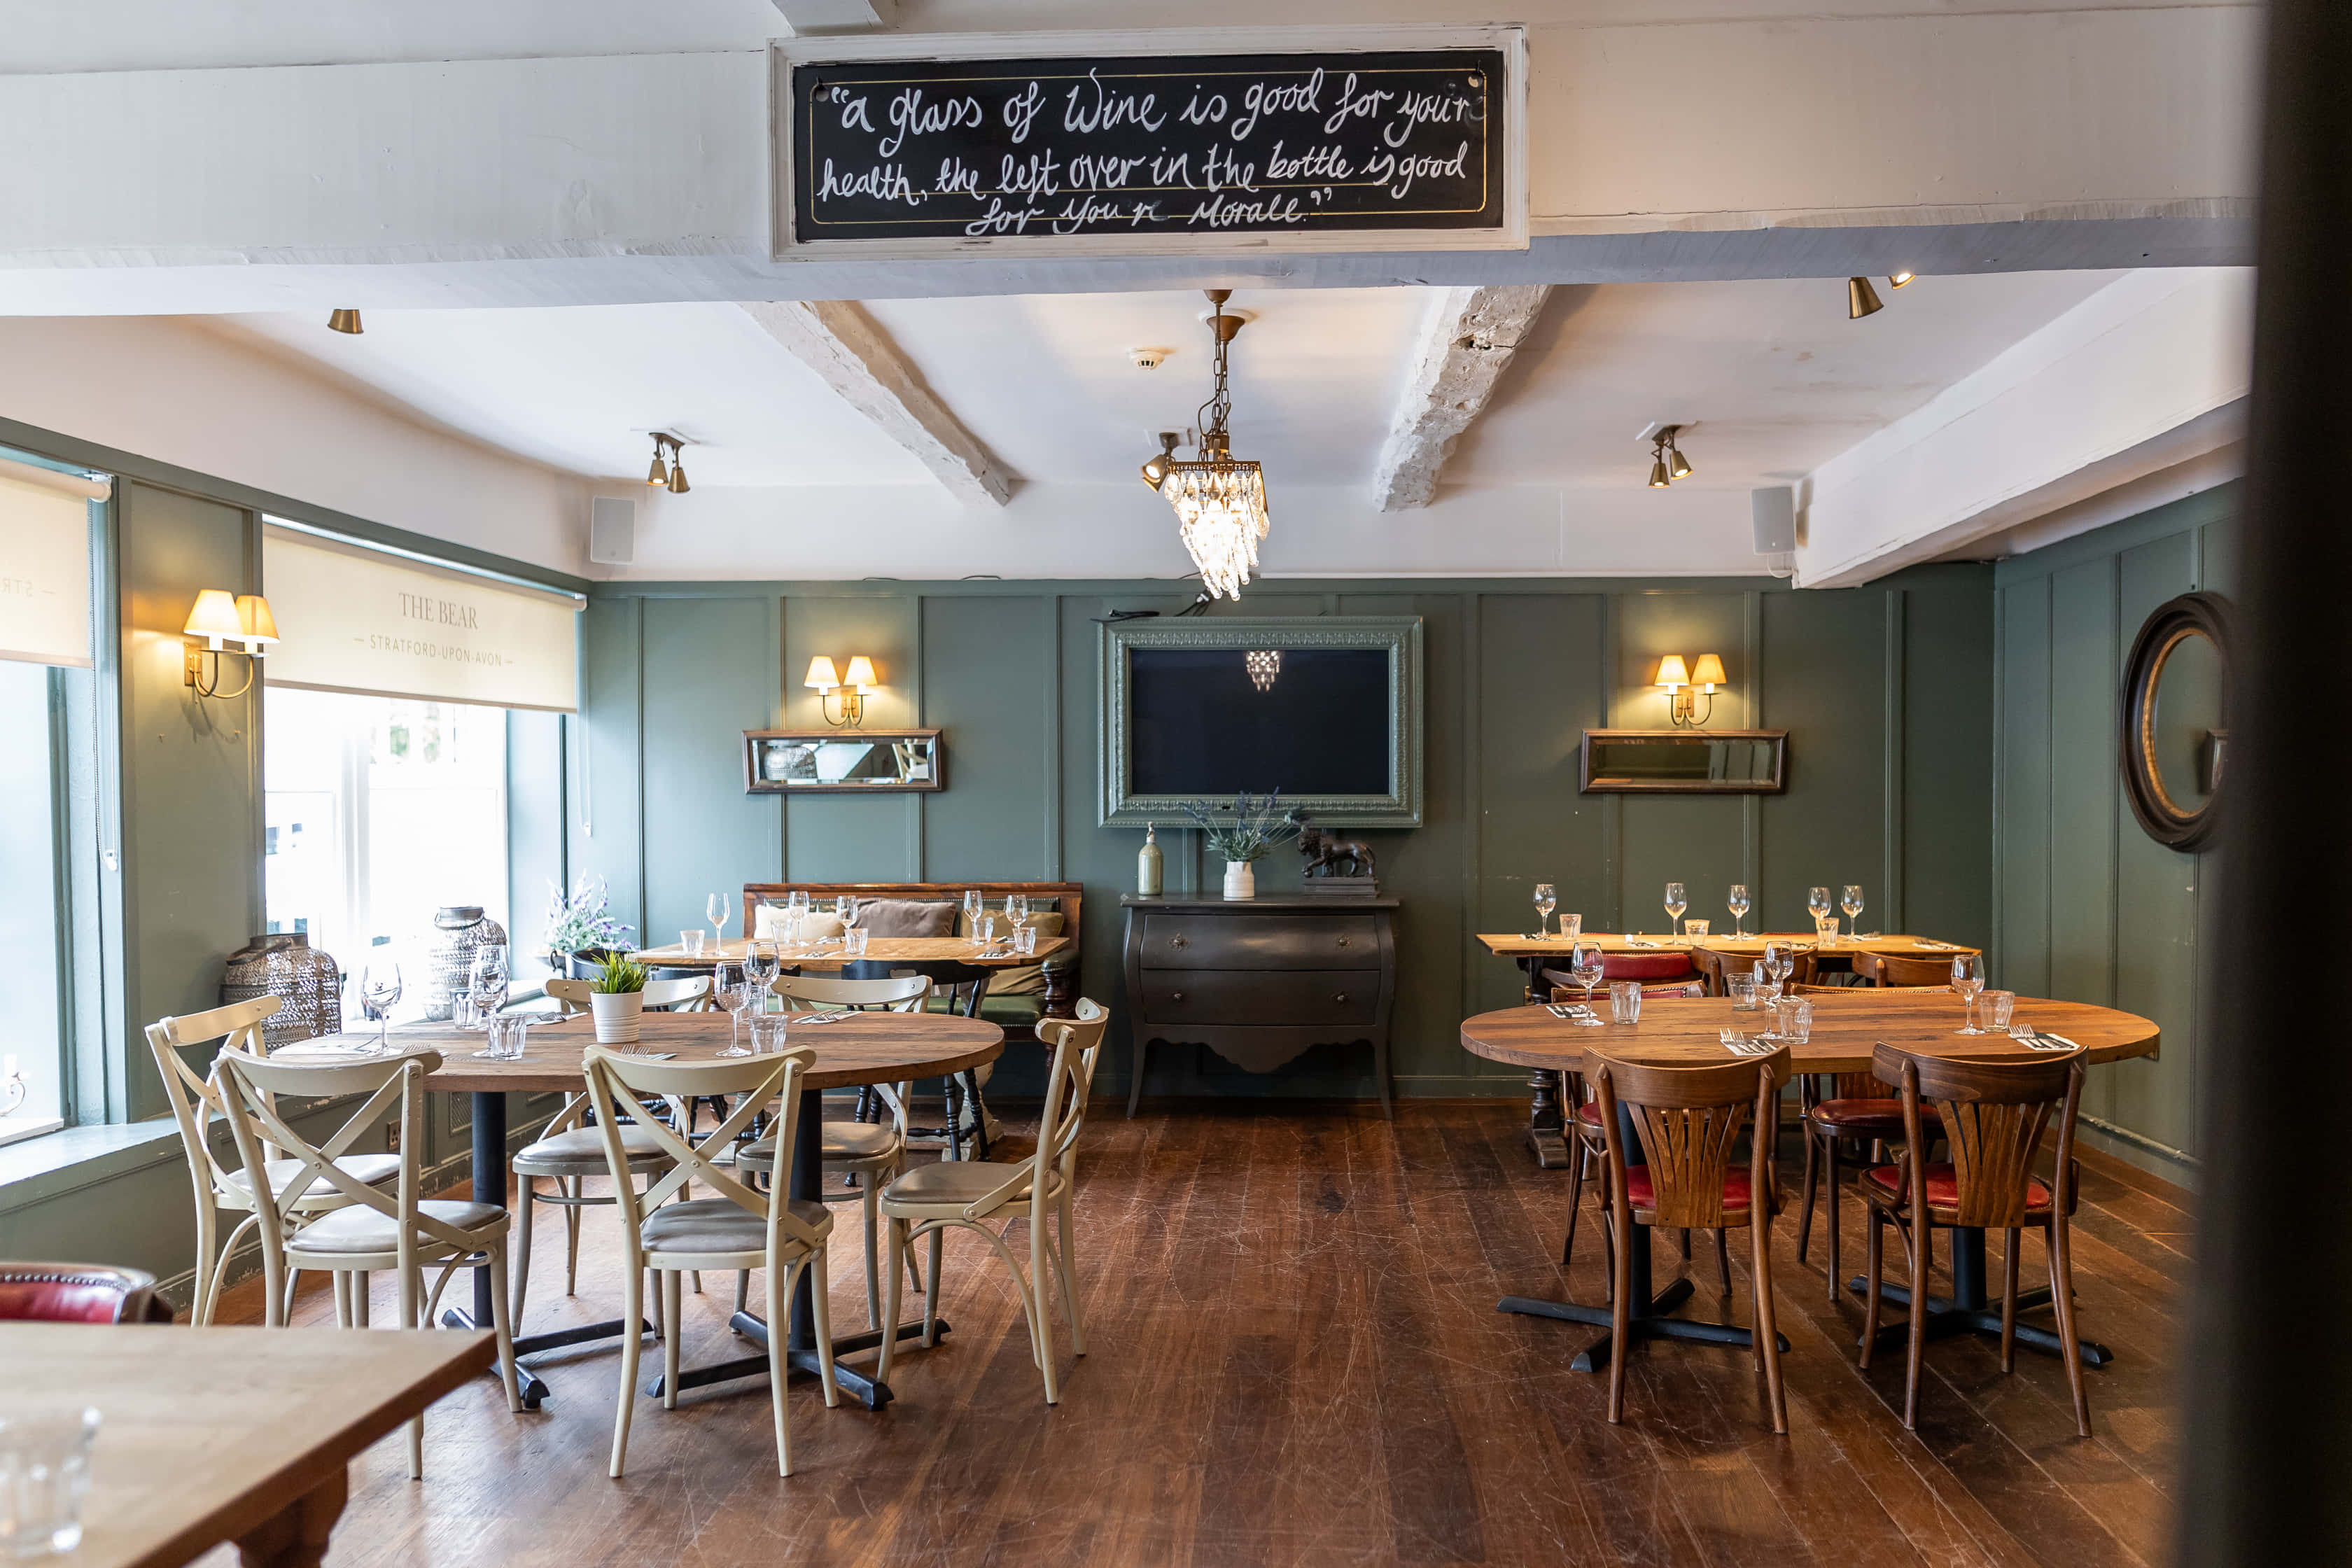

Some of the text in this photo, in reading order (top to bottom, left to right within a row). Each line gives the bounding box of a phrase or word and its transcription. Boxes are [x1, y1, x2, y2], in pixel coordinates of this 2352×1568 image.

[879, 88, 983, 158] glass
[1003, 80, 1046, 144] of
[1180, 84, 1228, 125] is
[1231, 67, 1324, 141] good
[1324, 73, 1394, 134] for
[934, 156, 986, 201] the
[995, 148, 1060, 204] left
[1069, 153, 1147, 192] over
[1149, 146, 1196, 190] in
[1202, 144, 1259, 192] the
[1266, 140, 1354, 180] bottle
[1360, 146, 1395, 186] is
[1392, 141, 1468, 199] good
[965, 197, 1045, 237] for
[398, 593, 479, 630] THE BEAR
